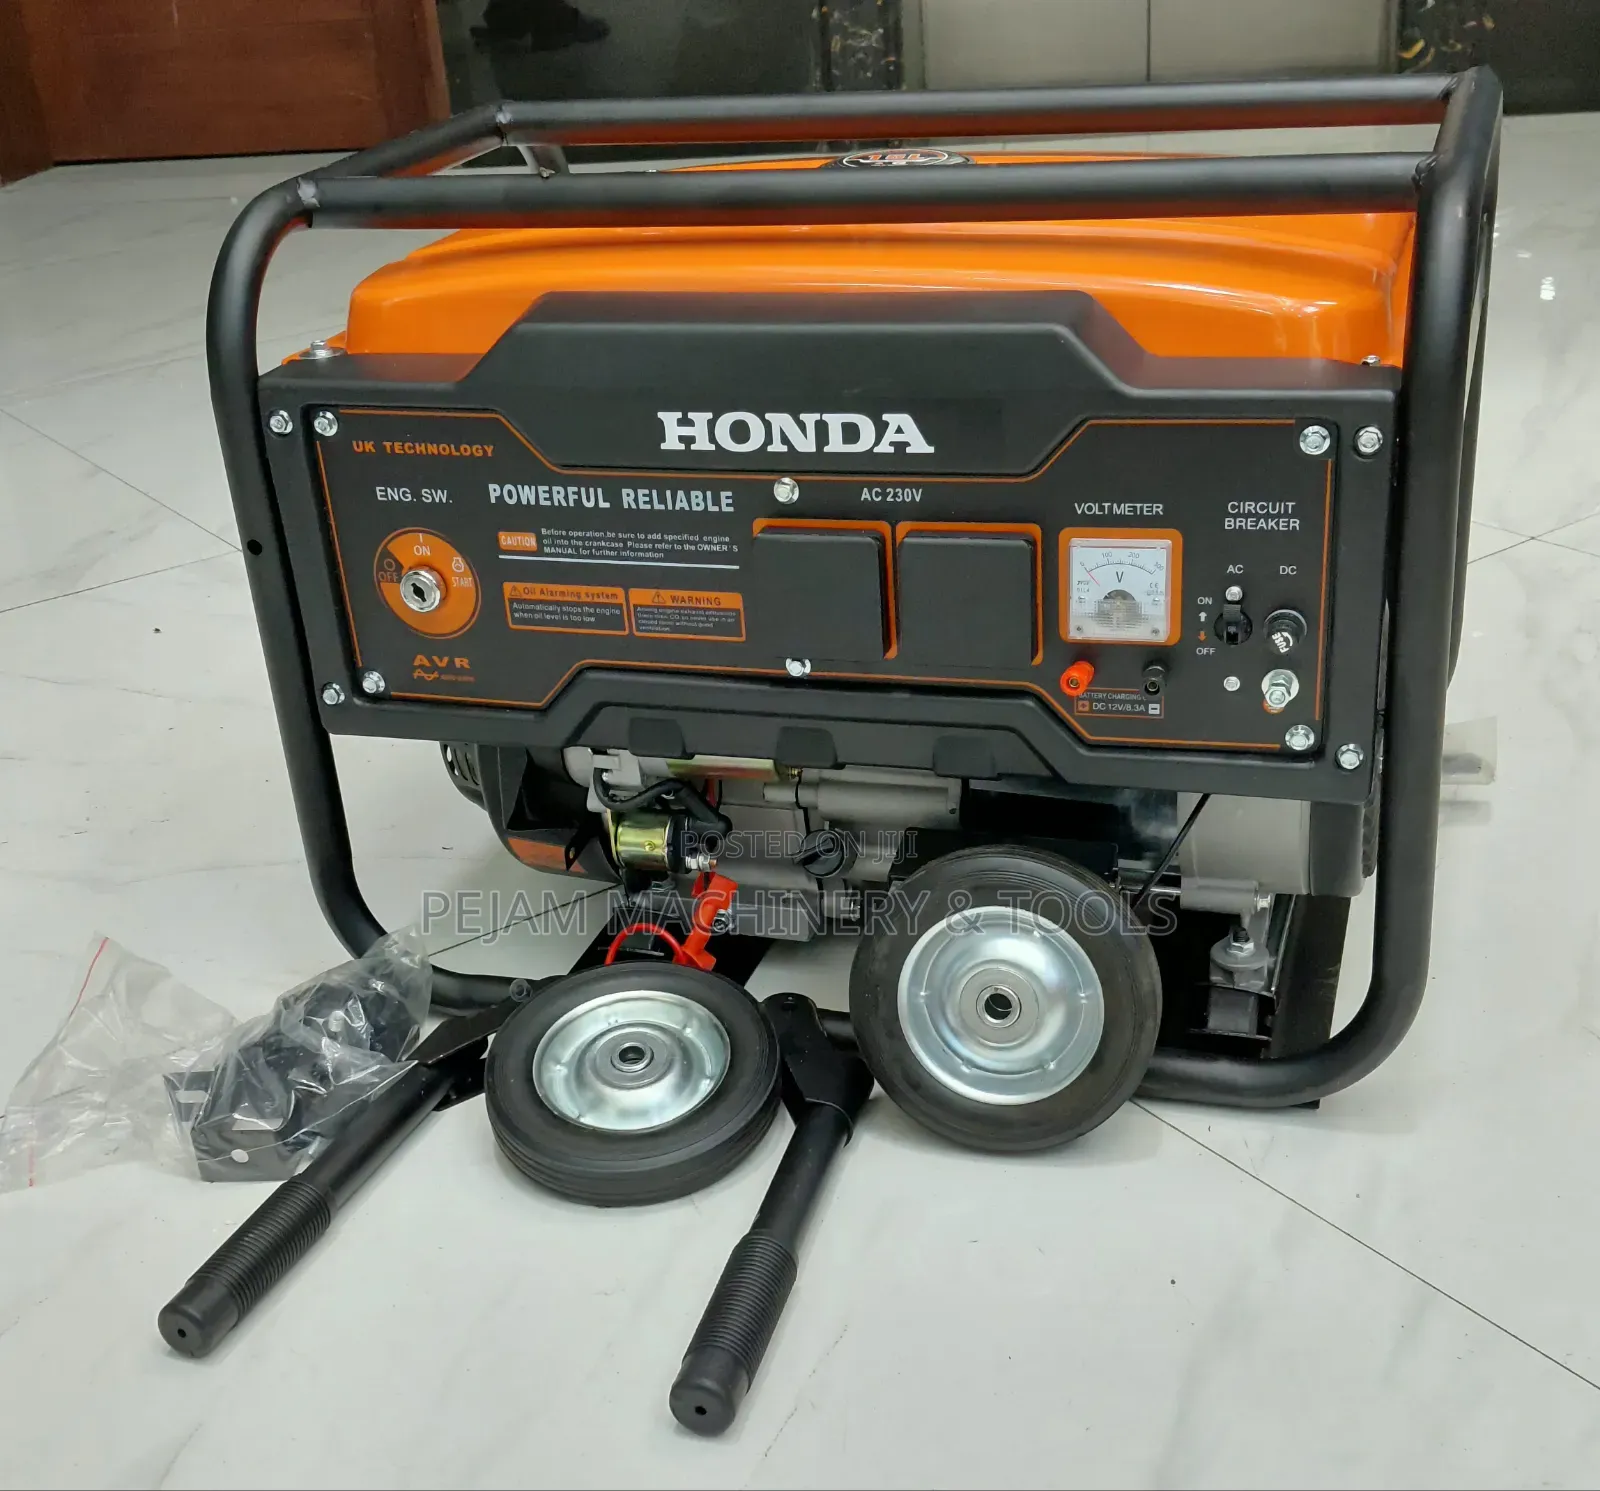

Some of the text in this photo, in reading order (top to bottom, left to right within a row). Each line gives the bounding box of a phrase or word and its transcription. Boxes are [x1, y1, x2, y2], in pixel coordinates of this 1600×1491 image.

[657, 411, 935, 454] HONDA
[352, 440, 494, 458] UK TECHNOLOGY
[375, 486, 453, 504] ENG. SW.
[488, 483, 735, 513] POWERFUL RELIABLE
[860, 487, 923, 503] AC 230V
[1227, 501, 1296, 514] CIRCUIT
[1224, 518, 1300, 531] BREAKER
[500, 534, 538, 548] CAUTION
[541, 527, 567, 537] Before
[646, 532, 662, 540] add
[663, 533, 699, 542] specified
[702, 535, 730, 544] engine
[413, 545, 431, 556] ON
[554, 538, 569, 546] into
[585, 540, 624, 548] crankcase
[627, 541, 653, 549] Please
[654, 542, 673, 550] refer
[674, 543, 682, 551] to
[684, 543, 696, 551] the
[543, 546, 664, 558] MANUAL for further information
[1101, 551, 1113, 559] 100
[1127, 551, 1140, 559] 200
[1226, 564, 1244, 574] AC
[1279, 565, 1297, 575] DC
[378, 571, 399, 582] OFF
[451, 576, 473, 588] START
[1115, 570, 1124, 583] V
[522, 586, 618, 601] Oil Alarming system
[670, 594, 722, 606] WARNING
[1197, 596, 1213, 606] ON
[512, 602, 621, 616] Automatically stops the engine
[513, 611, 533, 619] when
[544, 612, 561, 620] level
[562, 613, 569, 621] is
[1271, 631, 1290, 654] FUSE
[1196, 647, 1216, 656] OFF
[412, 654, 471, 669] AVR
[1107, 692, 1142, 701] CHARGING
[1092, 702, 1146, 712] DC 12V/8.3A
